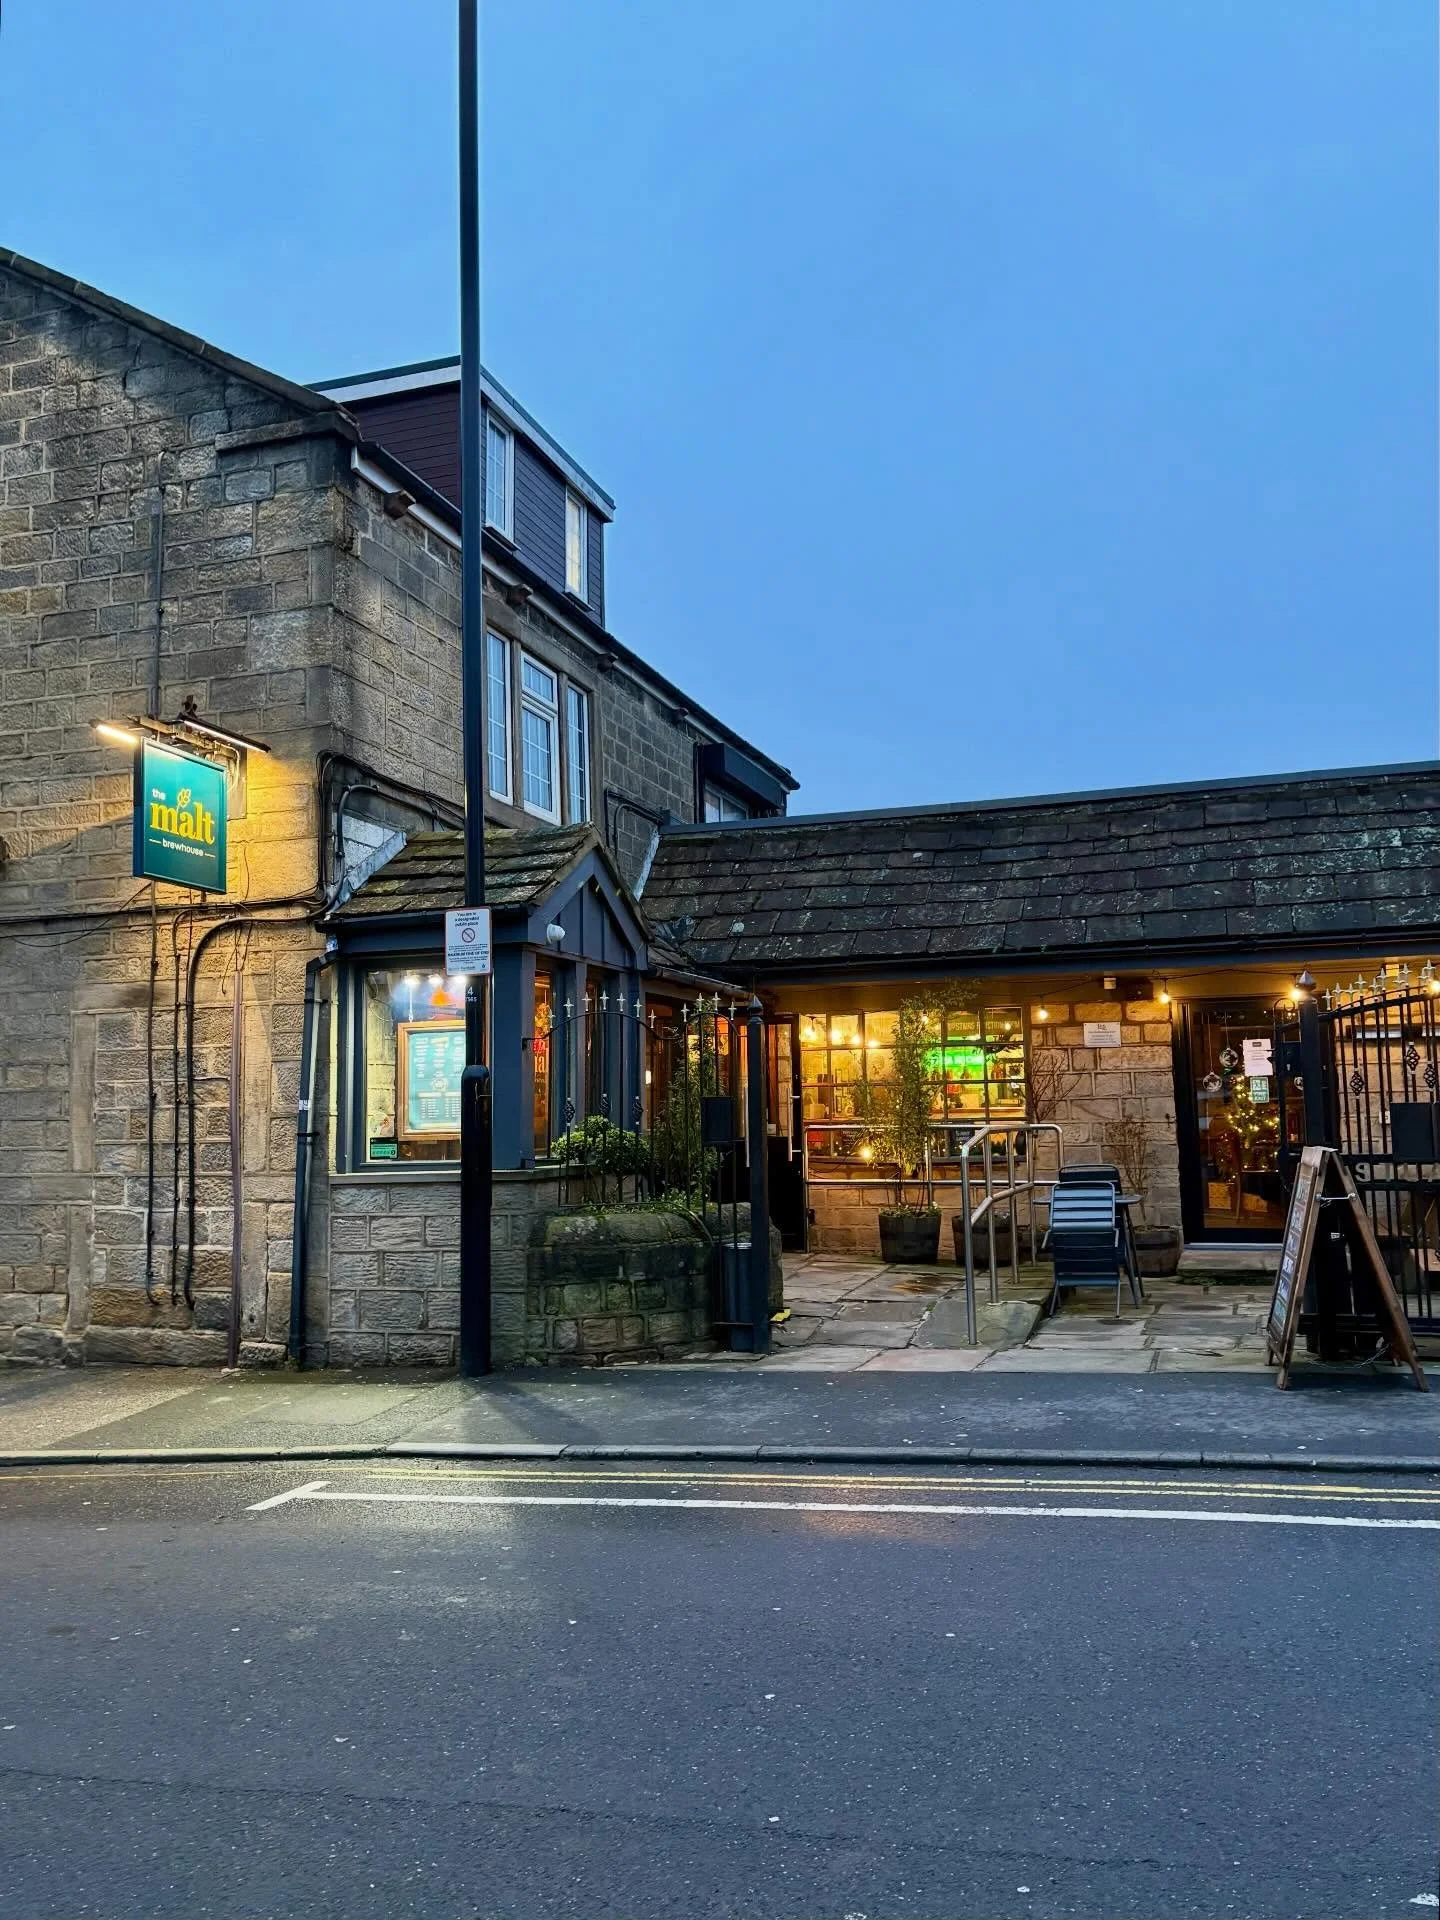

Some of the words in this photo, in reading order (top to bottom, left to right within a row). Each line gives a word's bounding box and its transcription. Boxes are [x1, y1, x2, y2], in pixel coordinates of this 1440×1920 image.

[152, 788, 166, 800] the
[150, 801, 215, 845] malt
[162, 838, 204, 857] brewhouse
